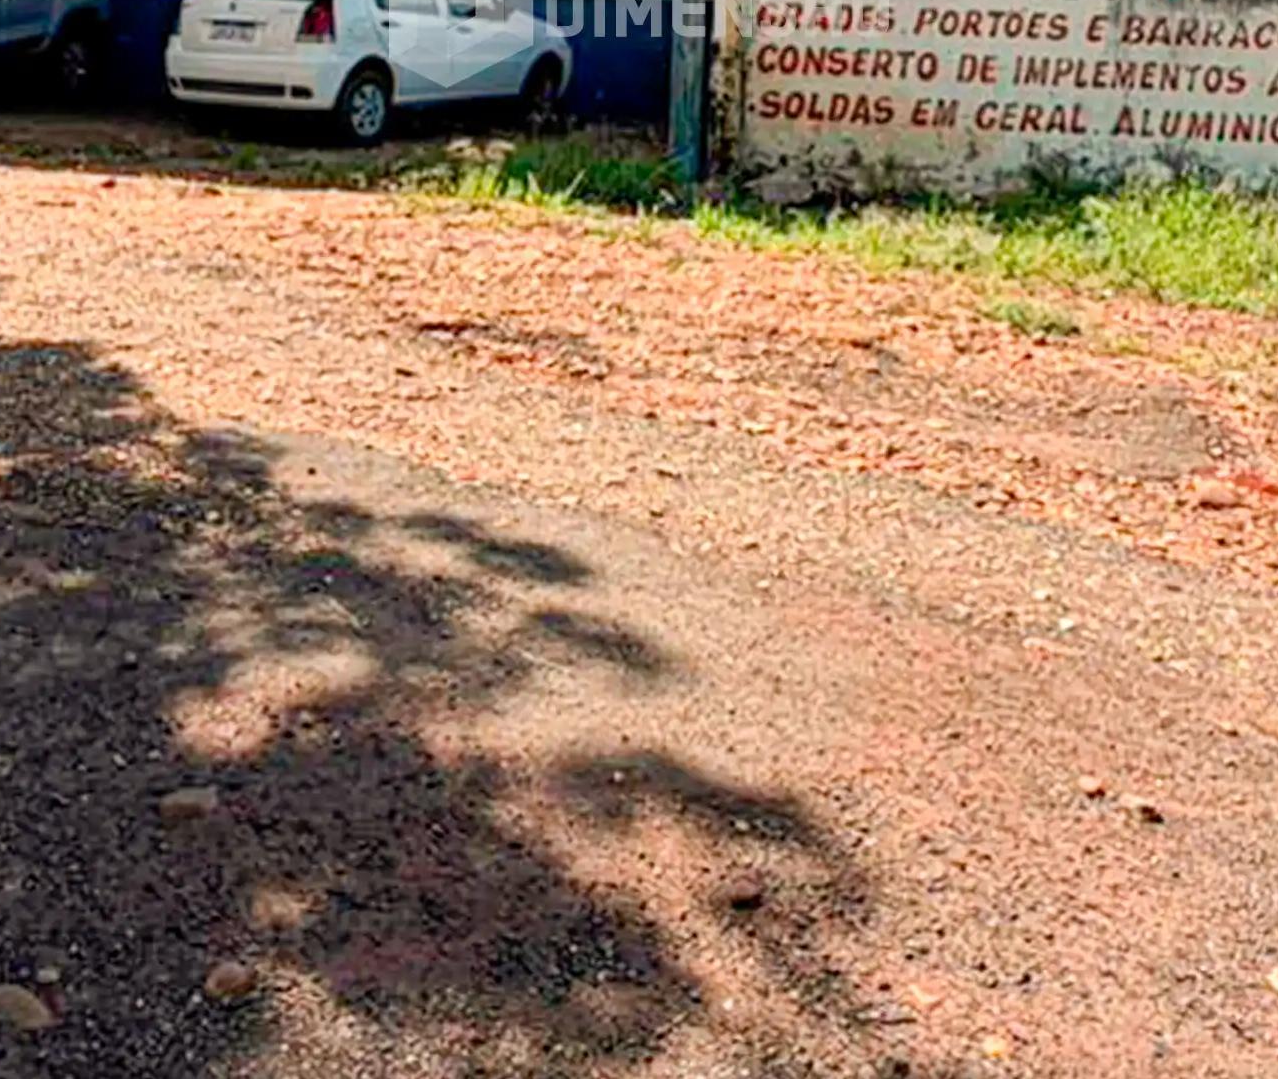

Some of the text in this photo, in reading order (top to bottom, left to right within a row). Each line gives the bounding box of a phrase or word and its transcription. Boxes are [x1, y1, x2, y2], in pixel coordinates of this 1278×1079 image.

[913, 7, 1070, 41] PORTOES
[1086, 14, 1109, 42] E
[756, 43, 938, 82] CONSERTO
[956, 53, 998, 85] DE
[1012, 55, 1247, 96] IMPLEMENTOS
[758, 90, 895, 126] SOLDAS
[910, 98, 957, 128] EM
